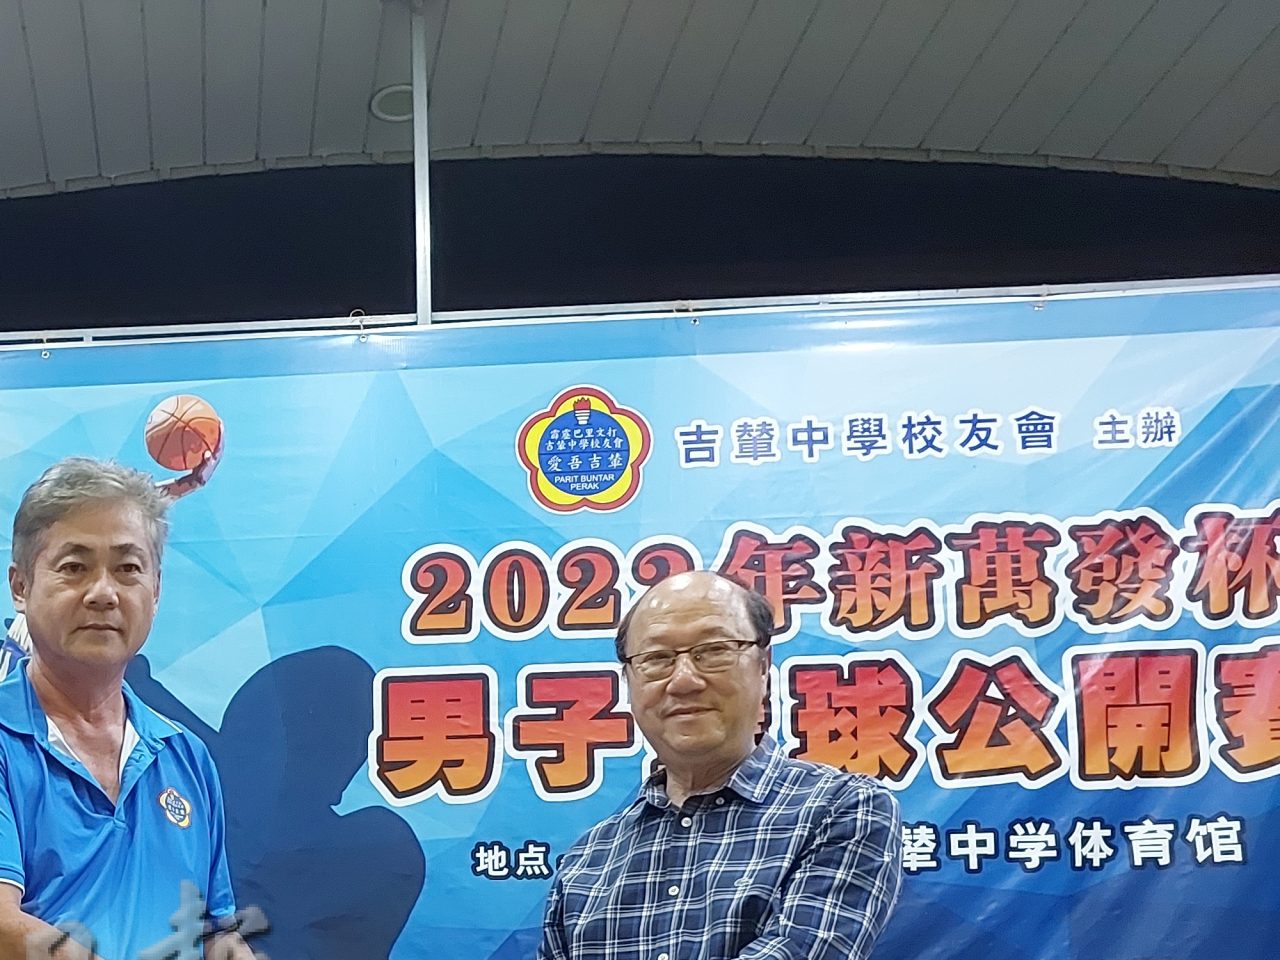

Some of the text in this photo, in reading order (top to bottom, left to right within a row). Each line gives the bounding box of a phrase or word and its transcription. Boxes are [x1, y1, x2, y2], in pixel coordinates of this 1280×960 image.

[677, 409, 1177, 464] 吉輦中學校友會 主辦
[554, 473, 615, 484] PARIT BUNTAR
[570, 482, 600, 491] PERAK
[377, 646, 1280, 796] 男子球公開
